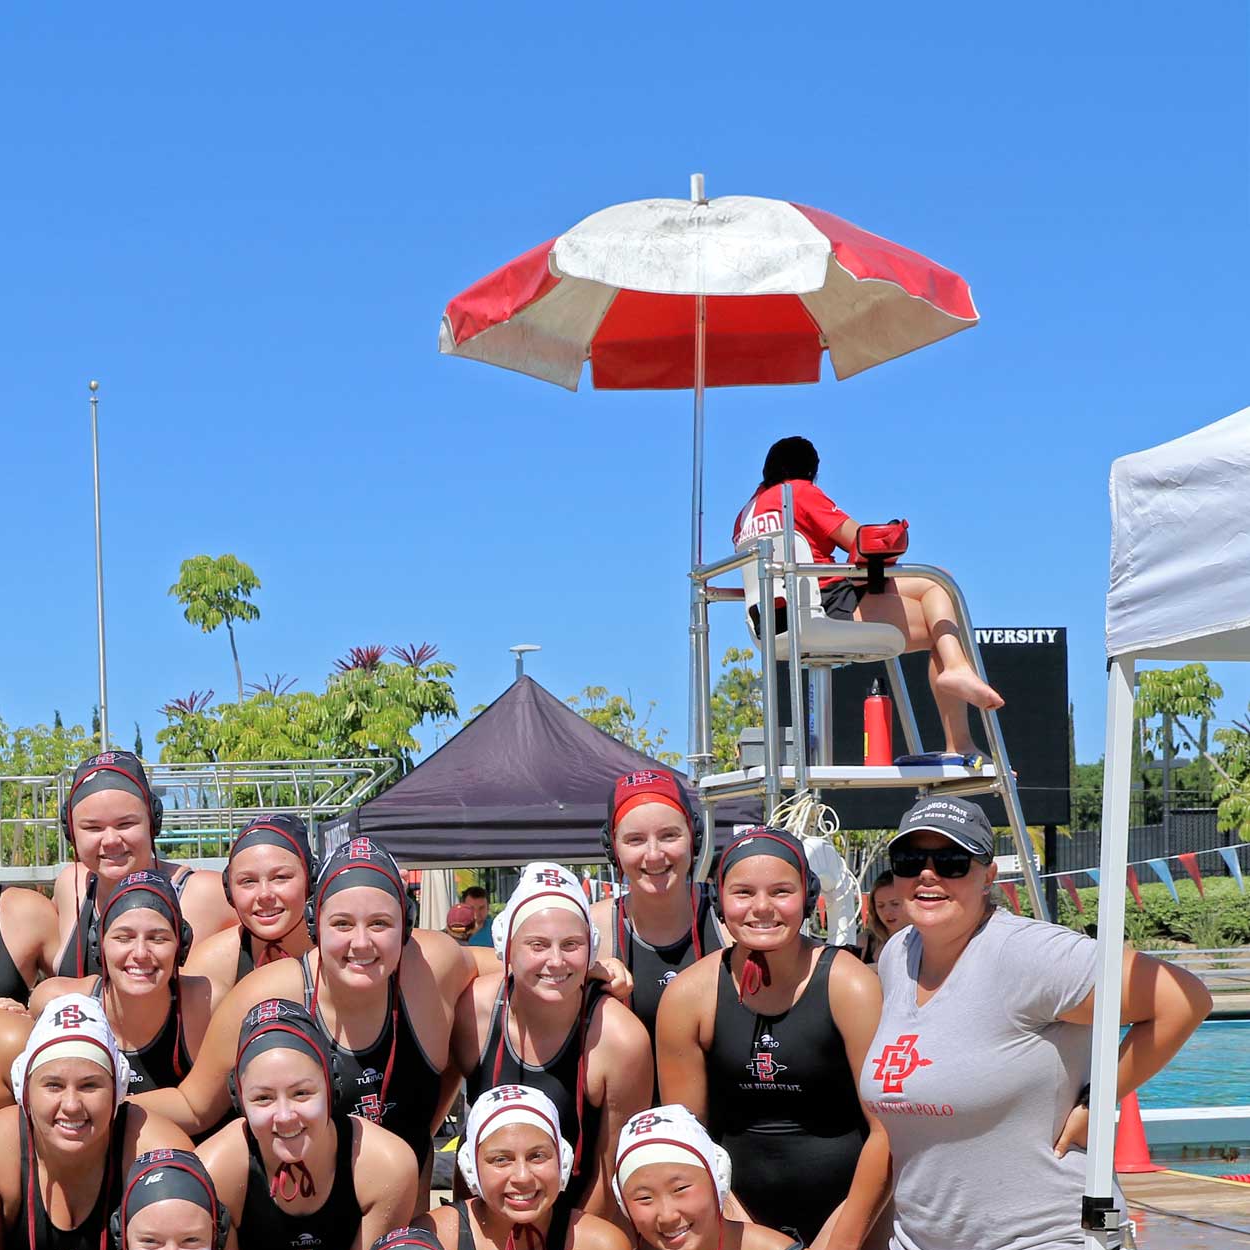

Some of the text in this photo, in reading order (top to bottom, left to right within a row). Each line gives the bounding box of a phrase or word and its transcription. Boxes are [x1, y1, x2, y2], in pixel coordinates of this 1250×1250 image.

[948, 804, 967, 818] STATE
[947, 814, 966, 824] POLO
[355, 1071, 384, 1085] TURBO
[754, 1082, 777, 1091] DIEGO
[915, 1103, 955, 1117] POLO
[291, 1238, 322, 1247] TURBO
